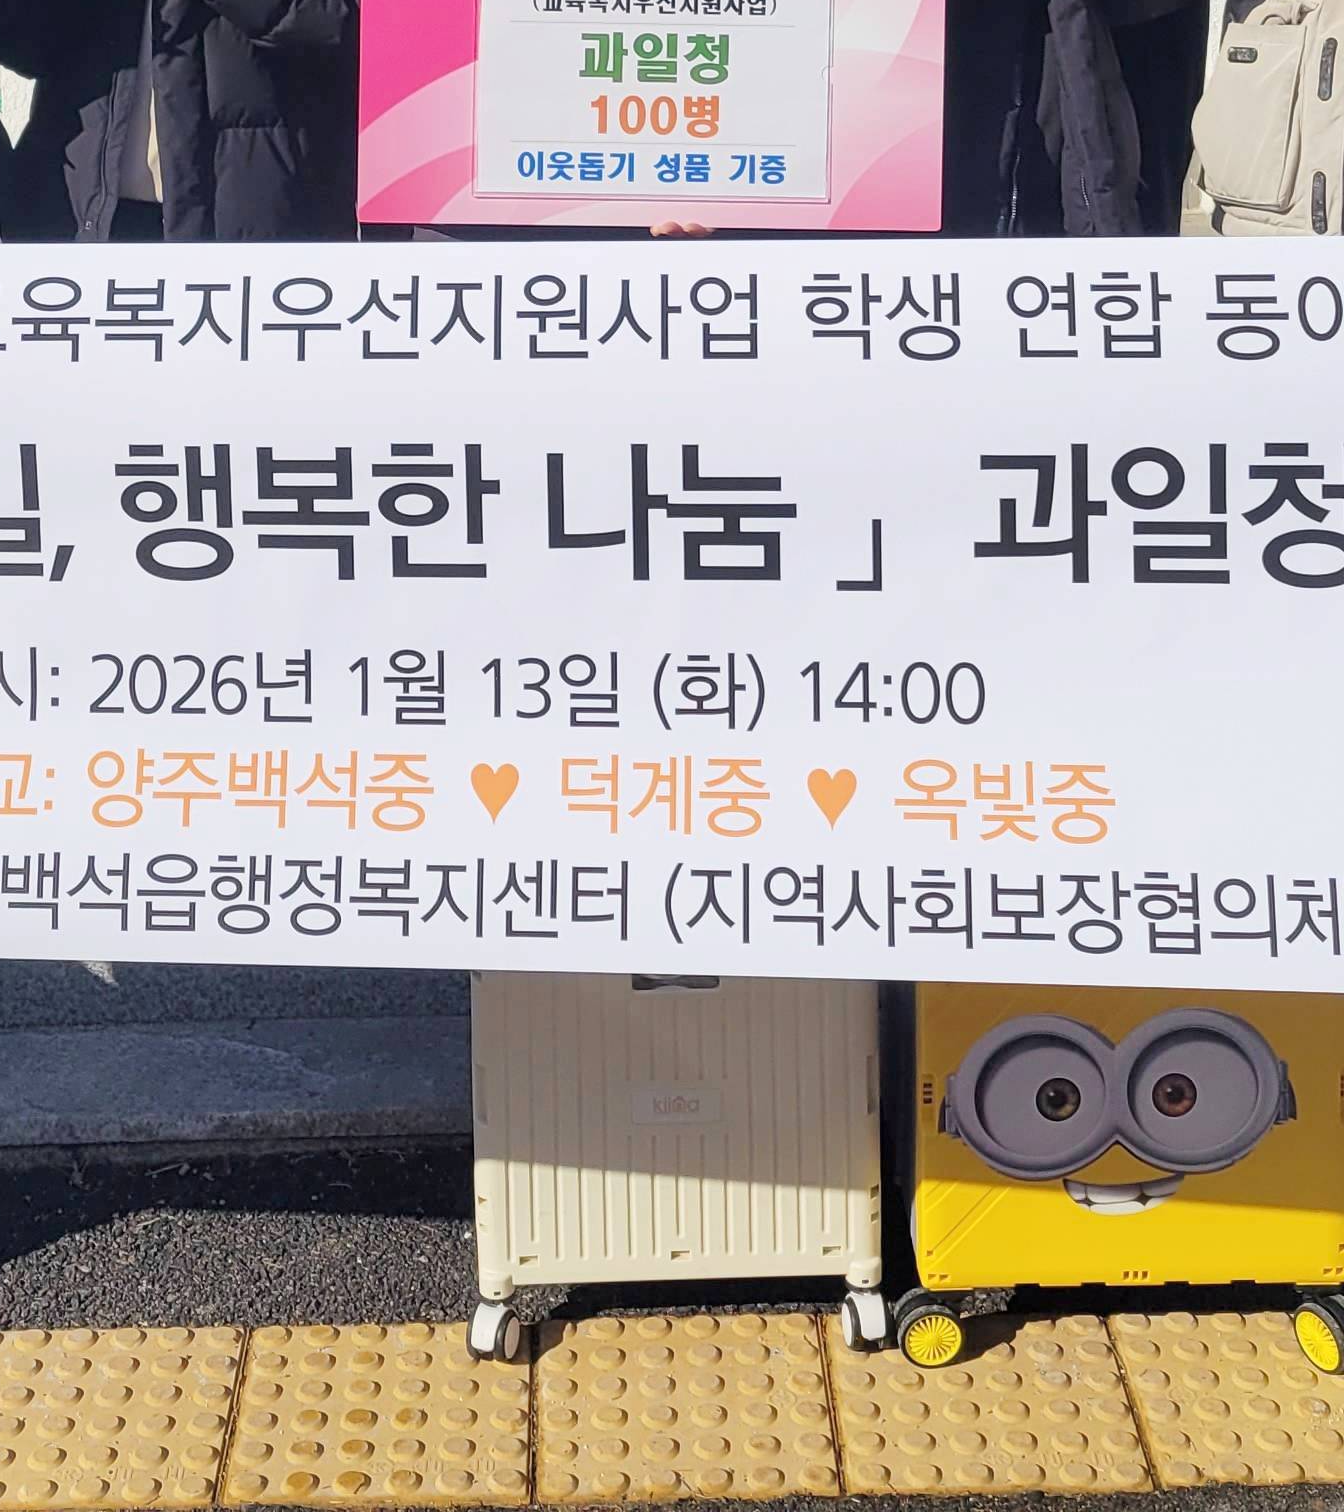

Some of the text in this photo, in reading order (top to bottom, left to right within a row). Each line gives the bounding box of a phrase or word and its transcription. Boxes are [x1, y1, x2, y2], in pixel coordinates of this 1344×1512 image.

[579, 32, 731, 84] 과일청
[589, 93, 722, 139] 100병
[517, 151, 788, 185] 이웃돕기 성품 기증
[801, 272, 962, 362] 학생
[1005, 271, 1173, 360] 연합
[113, 443, 502, 582] 행복한
[546, 443, 798, 582] 나눔
[88, 649, 314, 724] 2026년
[348, 649, 447, 727] 1월
[480, 651, 621, 729] 13일
[652, 652, 766, 733] (화)
[799, 660, 987, 726] 14:00
[85, 748, 436, 834] 양주백석중
[559, 754, 771, 839] 덕계중
[894, 758, 1117, 845] 옥빛중
[0, 851, 630, 945] 백석읍행정복지센터
